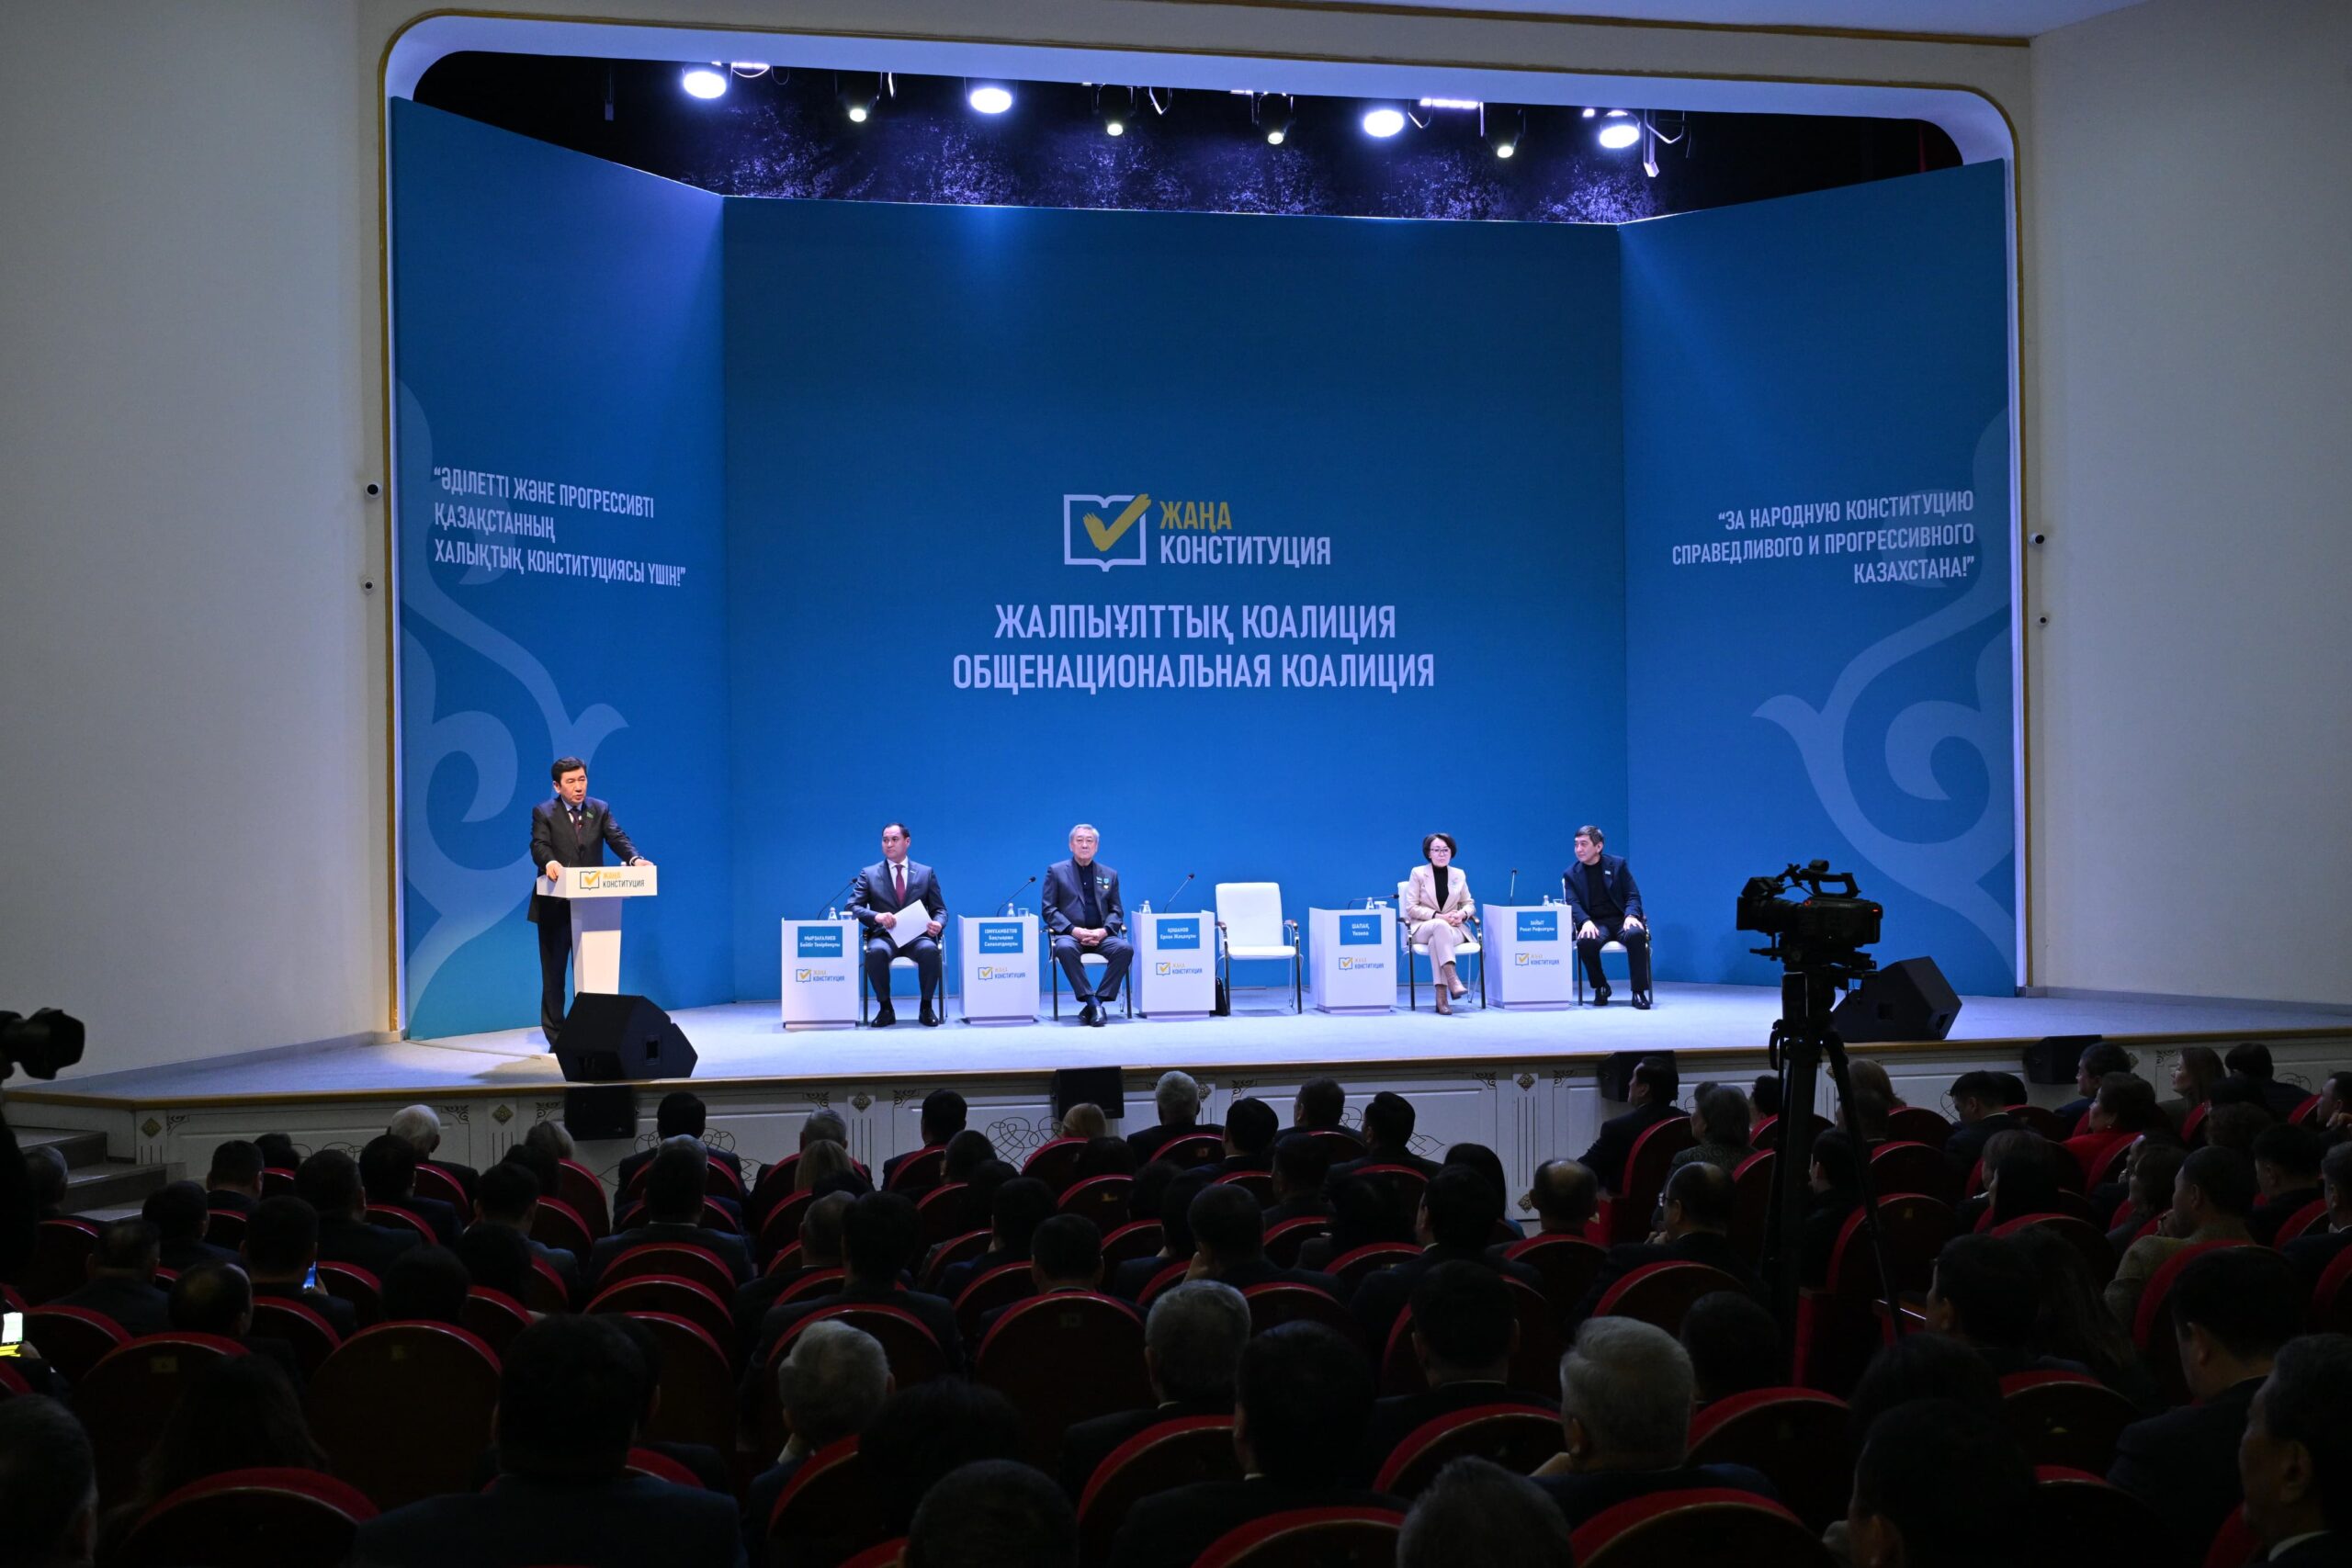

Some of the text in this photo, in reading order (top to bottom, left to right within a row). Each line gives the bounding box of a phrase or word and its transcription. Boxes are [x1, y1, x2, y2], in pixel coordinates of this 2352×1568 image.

[434, 467, 654, 518] “ӘДІЛЕТТІ ЖӘНЕ ПРОГРЕССИВТІ
[1718, 490, 1974, 530] “ЗА НАРОДНУЮ КОНСТИТУЦИЮ
[434, 502, 556, 543] ҚАЗАҚСТАННЫҢ
[1159, 501, 1232, 533] ЖАҢА
[435, 538, 686, 587] ХАЛЫҚТЫҚ КОНСТИТУЦИЯСЫ ҮШІН!”
[1159, 536, 1331, 568] КОНСТИТУЦИЯ
[1672, 523, 1974, 565] СПРАВЕДЛИВОГО И ПРОГРЕССИВНОГО
[1854, 556, 1974, 584] КАЗАХСТАНА!”
[994, 604, 1396, 645] ЖАЛПЫҰЛТТЫҚ КОАЛИЦИЯ
[953, 653, 1434, 694] ОБЩЕНАЦИОНАЛЬНАЯ КОАЛИЦИЯ
[603, 879, 645, 888] КОНСТИТУЦИЯ
